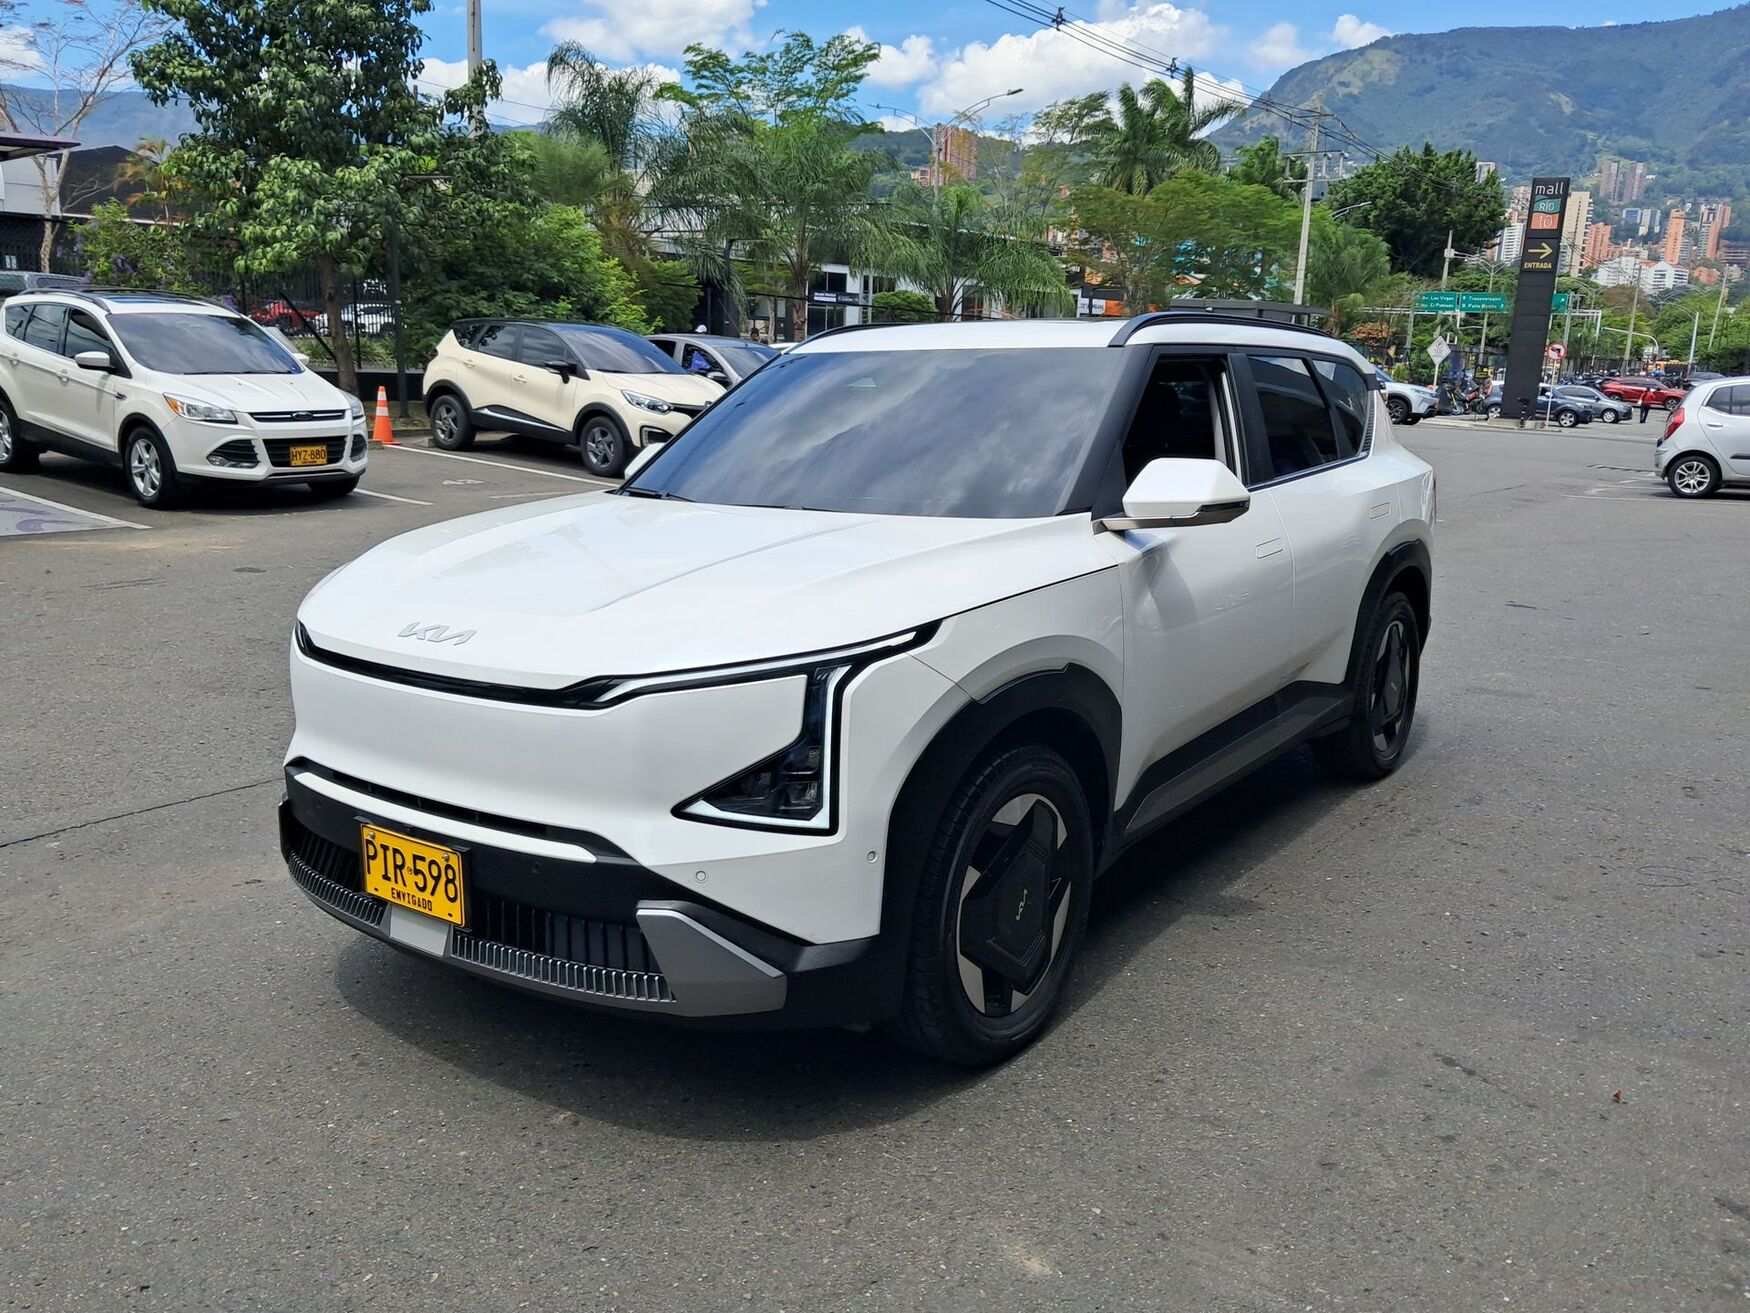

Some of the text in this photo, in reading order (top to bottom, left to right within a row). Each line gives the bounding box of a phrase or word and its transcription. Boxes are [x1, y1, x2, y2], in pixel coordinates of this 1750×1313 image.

[1535, 182, 1564, 195] mall
[1539, 215, 1553, 229] 10
[391, 887, 433, 912] ENVIGADO
